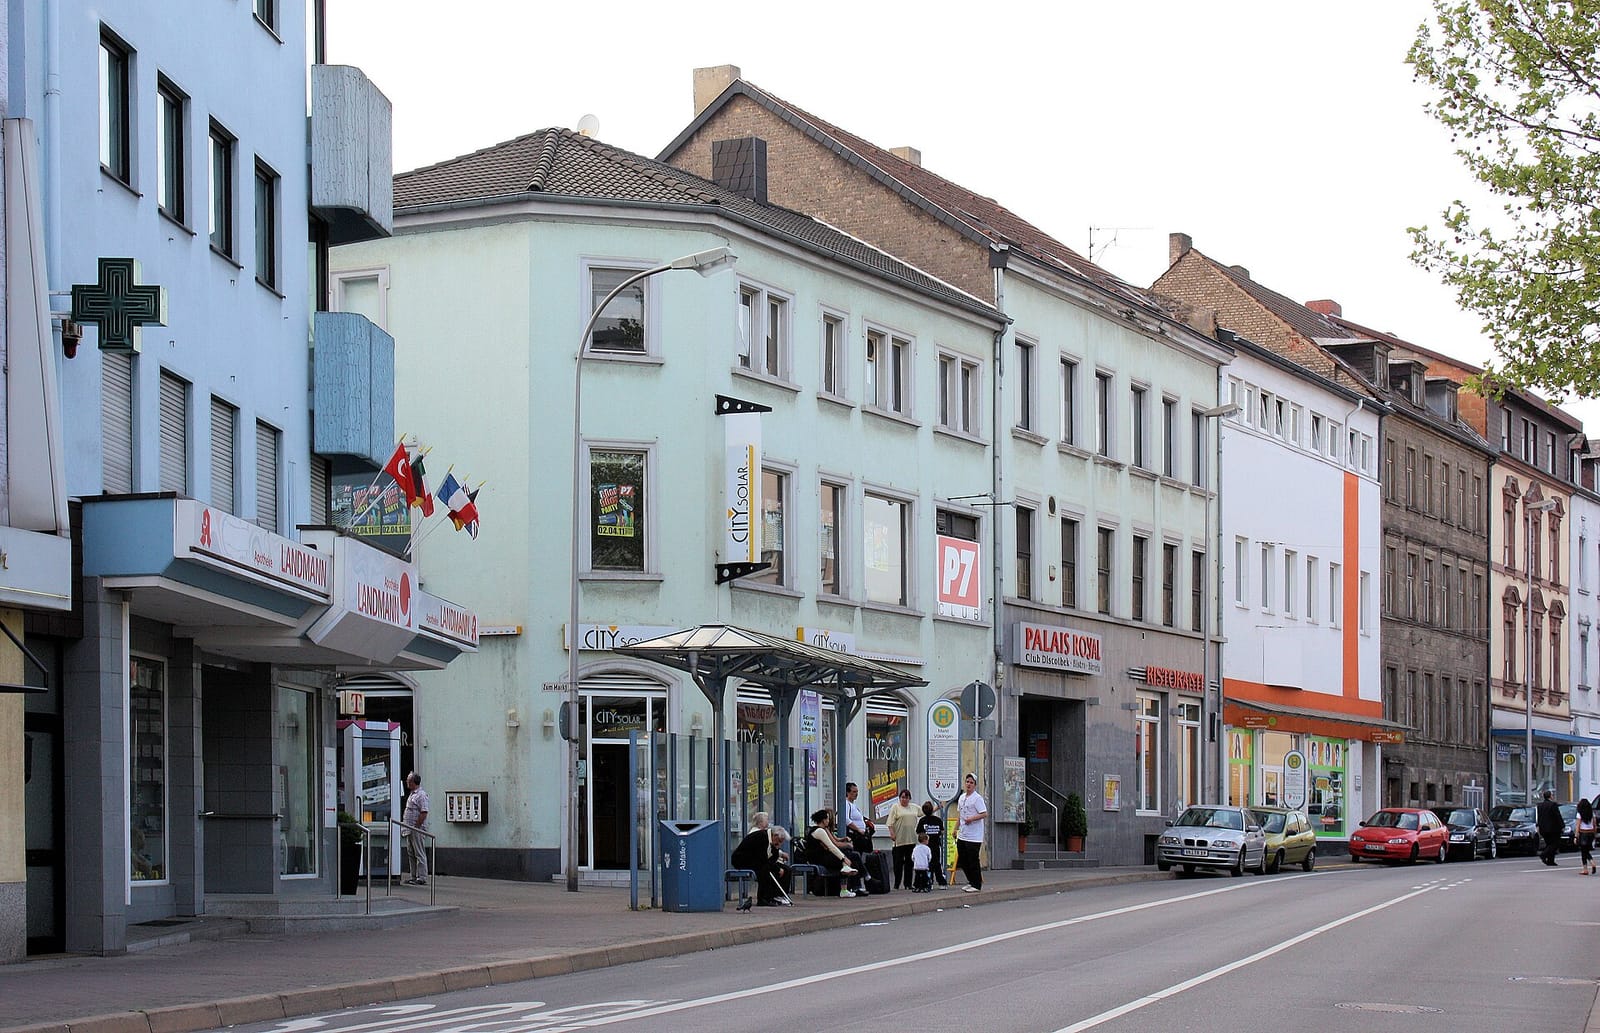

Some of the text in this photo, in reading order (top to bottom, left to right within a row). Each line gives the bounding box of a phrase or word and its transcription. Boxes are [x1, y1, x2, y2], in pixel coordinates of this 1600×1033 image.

[601, 504, 618, 514] PARTY
[727, 467, 749, 543] CITY SOLAR
[382, 526, 405, 534] 02.04.11
[598, 526, 625, 535] 02.04.11
[253, 543, 327, 588] Apotheke LANDMANN
[942, 545, 977, 599] P7
[358, 583, 400, 624] LANDMANN
[937, 602, 979, 621] CLUB
[440, 604, 470, 634] LANDMANN
[584, 625, 620, 650] CITY
[813, 630, 830, 649] CITY
[1025, 627, 1101, 661] PALAIS ROYAL
[1025, 653, 1041, 665] Club
[1041, 655, 1069, 668] Discothek
[351, 693, 362, 713] T
[597, 709, 641, 725] CITY SOLAR
[881, 745, 902, 761] SOLAR
